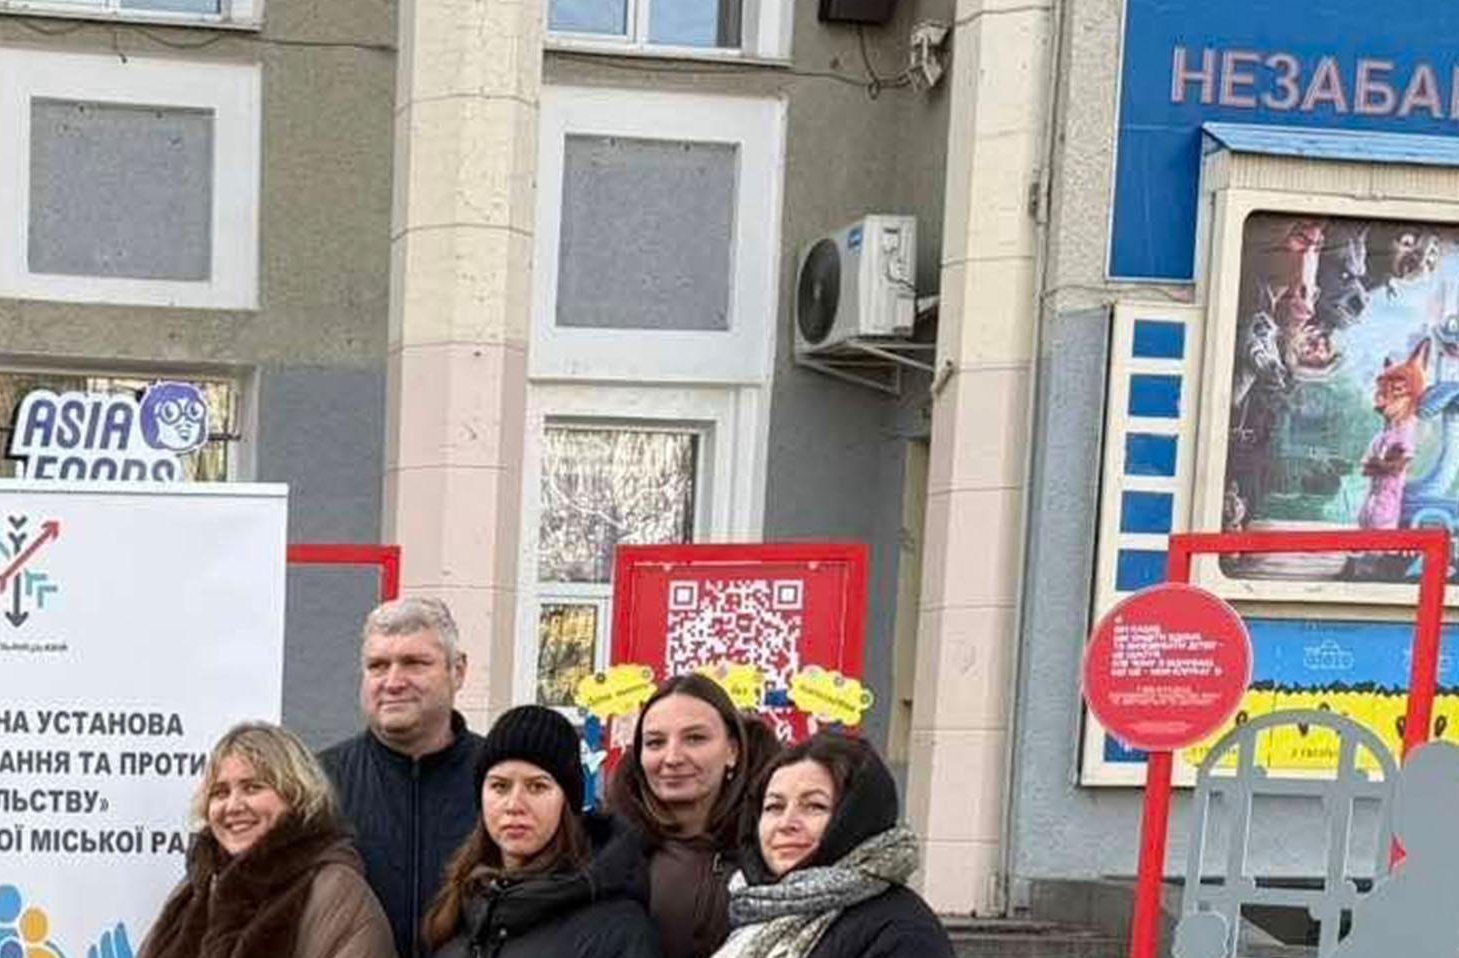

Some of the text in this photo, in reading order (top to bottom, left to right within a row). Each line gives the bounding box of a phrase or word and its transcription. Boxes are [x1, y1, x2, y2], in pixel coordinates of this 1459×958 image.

[1169, 45, 1459, 120] НЕЗАБА
[22, 398, 134, 450] ASIA
[37, 710, 184, 736] УСТАНОВА
[78, 751, 112, 775] ТА
[119, 751, 207, 777] ПРОТИ
[30, 825, 144, 854] МІСЬКОЇ
